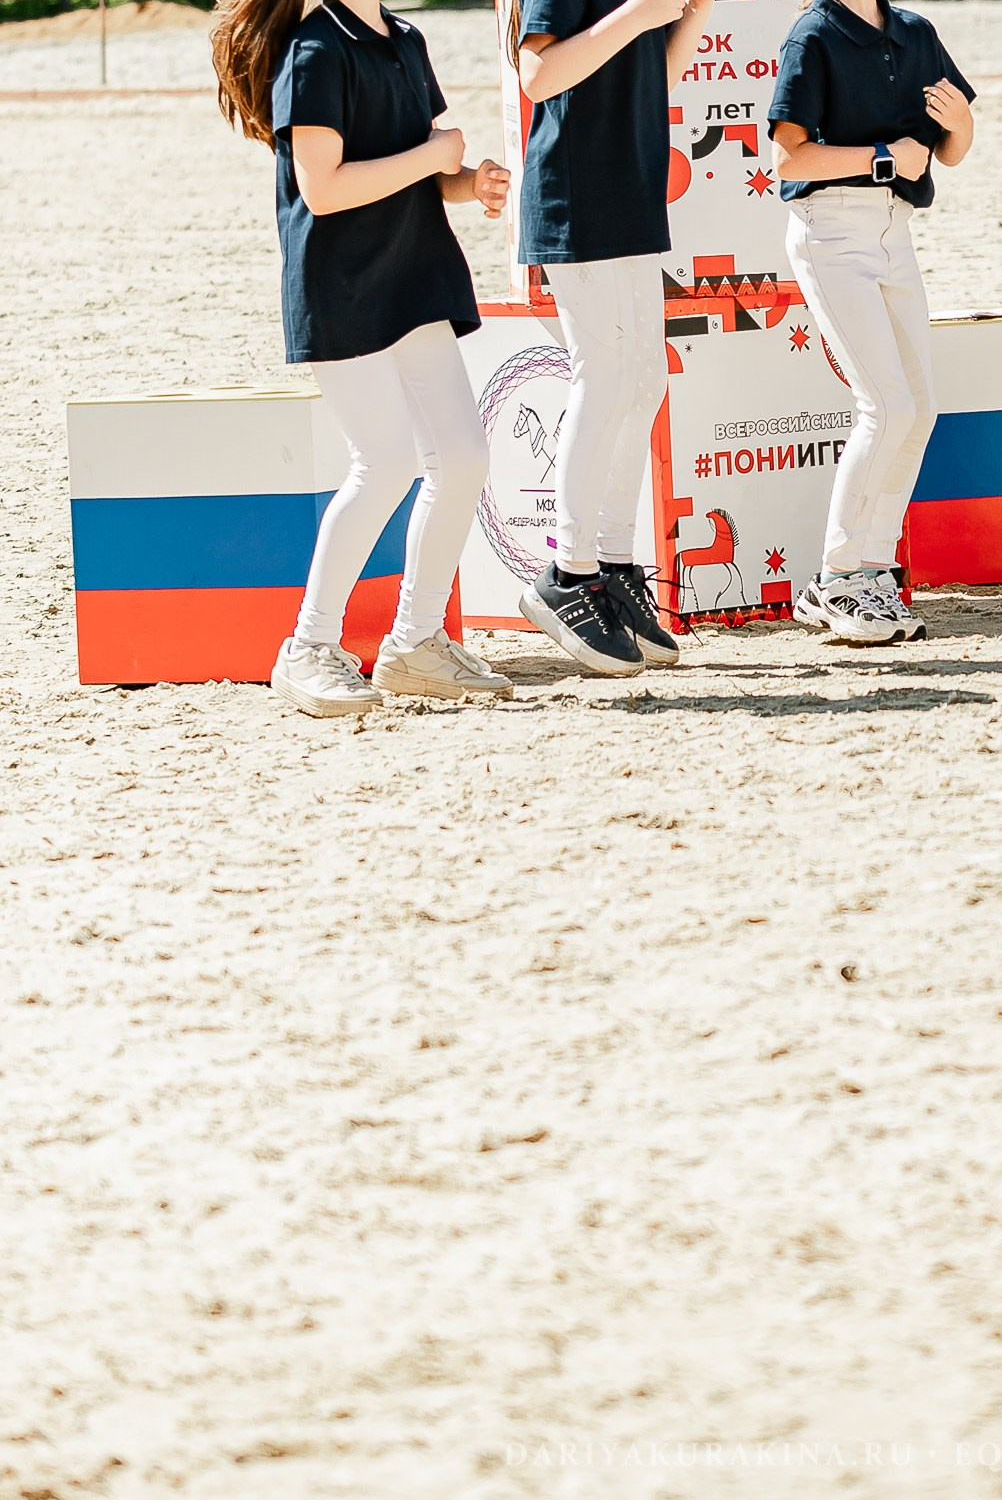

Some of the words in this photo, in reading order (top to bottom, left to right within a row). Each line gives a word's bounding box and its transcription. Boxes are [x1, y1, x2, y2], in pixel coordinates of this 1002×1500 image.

[696, 33, 733, 53] ОК
[681, 61, 738, 82] НТА
[705, 102, 755, 120] лет
[714, 411, 853, 440] ВСЕРОССИЙСКИЕ
[694, 439, 848, 479] #ПОНИИГР
